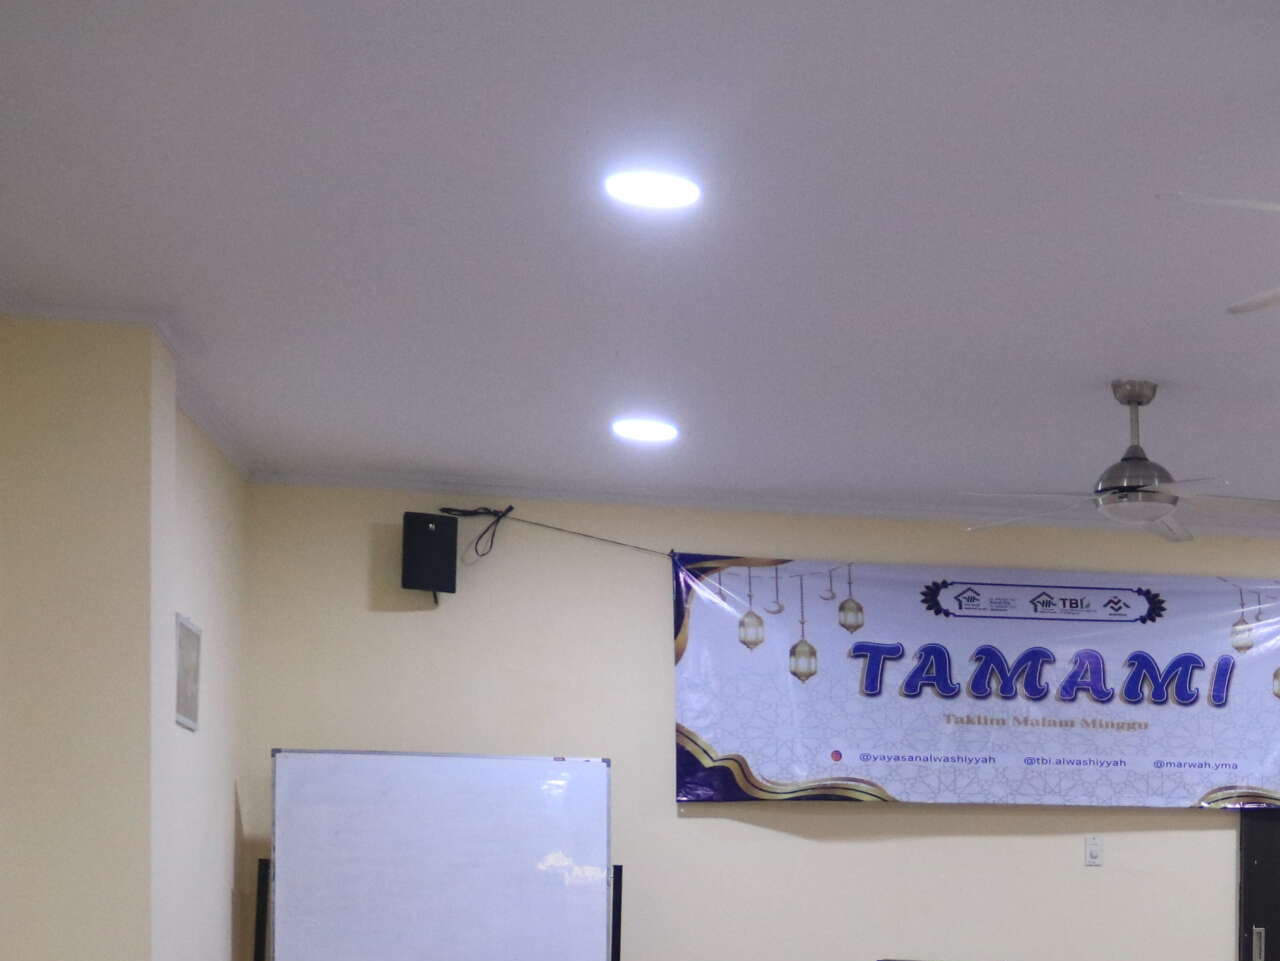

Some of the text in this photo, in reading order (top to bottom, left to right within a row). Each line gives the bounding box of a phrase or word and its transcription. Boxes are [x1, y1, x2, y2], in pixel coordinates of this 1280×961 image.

[851, 641, 1235, 707] TAMAMI
[943, 713, 1149, 733] Taklim Malam Minggu
[859, 752, 1239, 771] @yayasanalwashiyyah @tbi.alwashiyyah @marwah.yma
